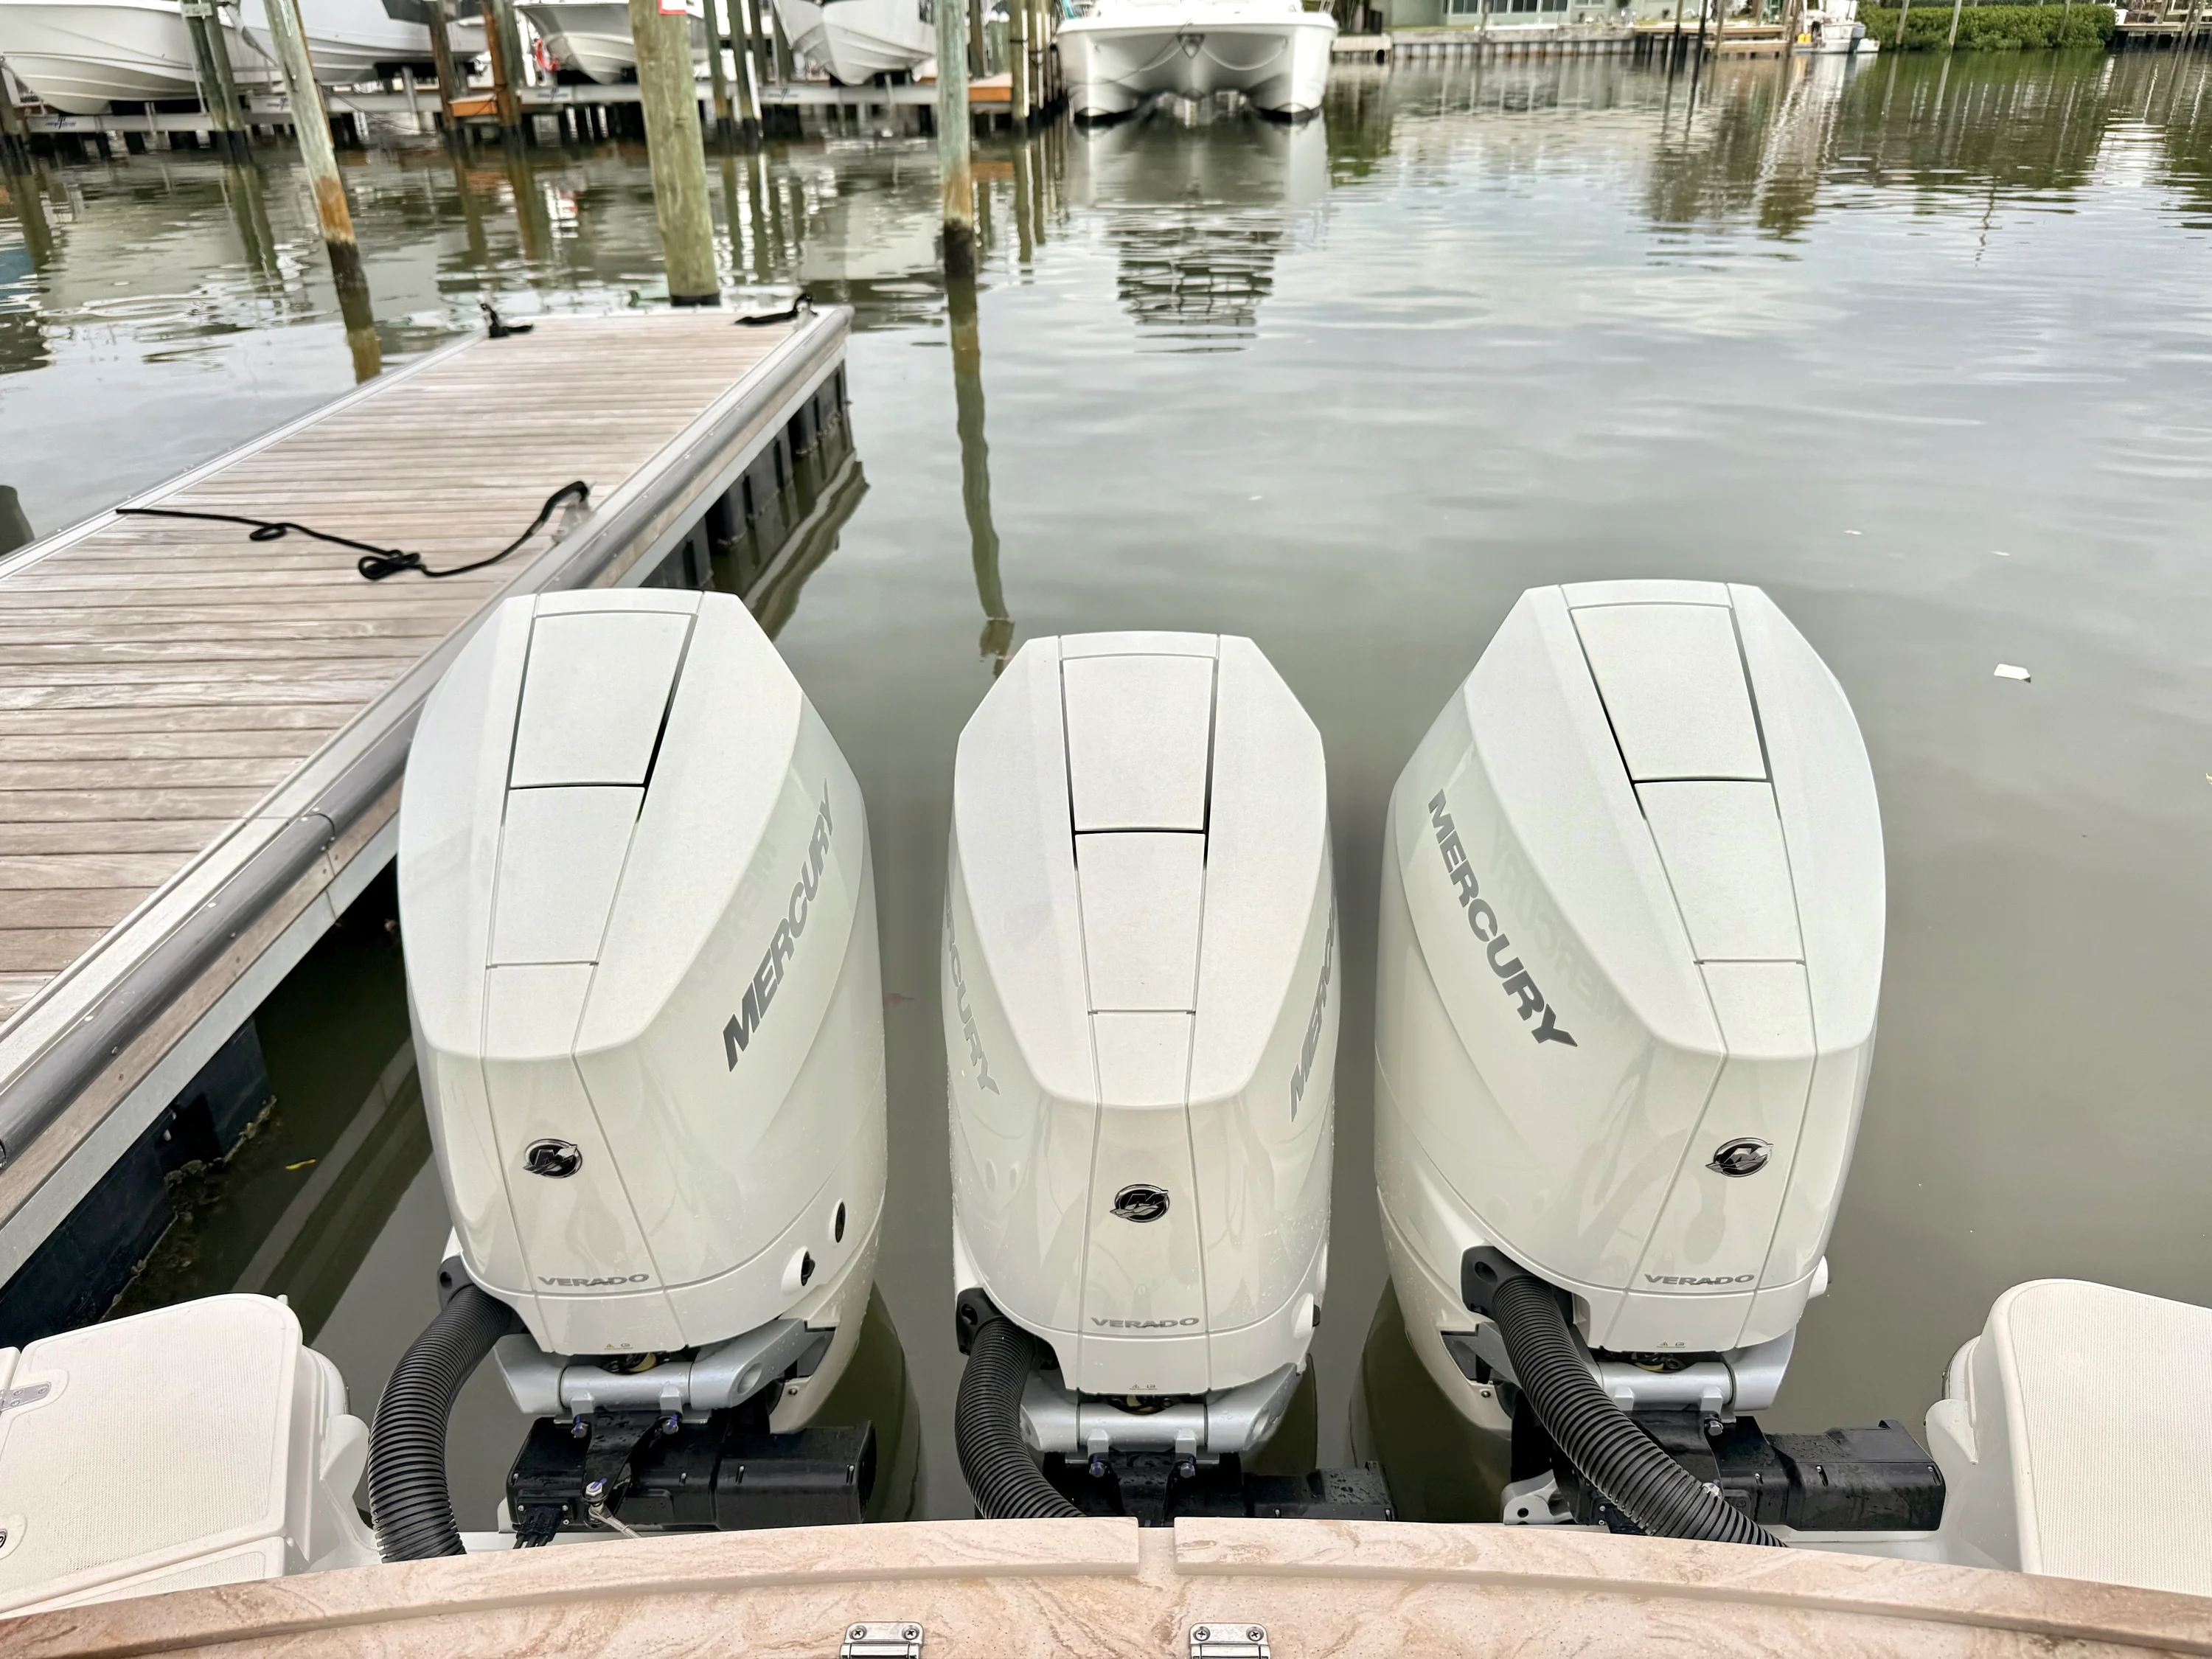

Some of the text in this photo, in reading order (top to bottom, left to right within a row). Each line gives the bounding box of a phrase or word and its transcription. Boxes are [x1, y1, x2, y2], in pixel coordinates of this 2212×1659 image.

[723, 776, 833, 1073] MERCURY
[1427, 788, 1578, 1048] MERCURY
[537, 1273, 650, 1287] VERADO
[1644, 1273, 1755, 1285] VERADO
[1091, 1317, 1200, 1329] VERADO
